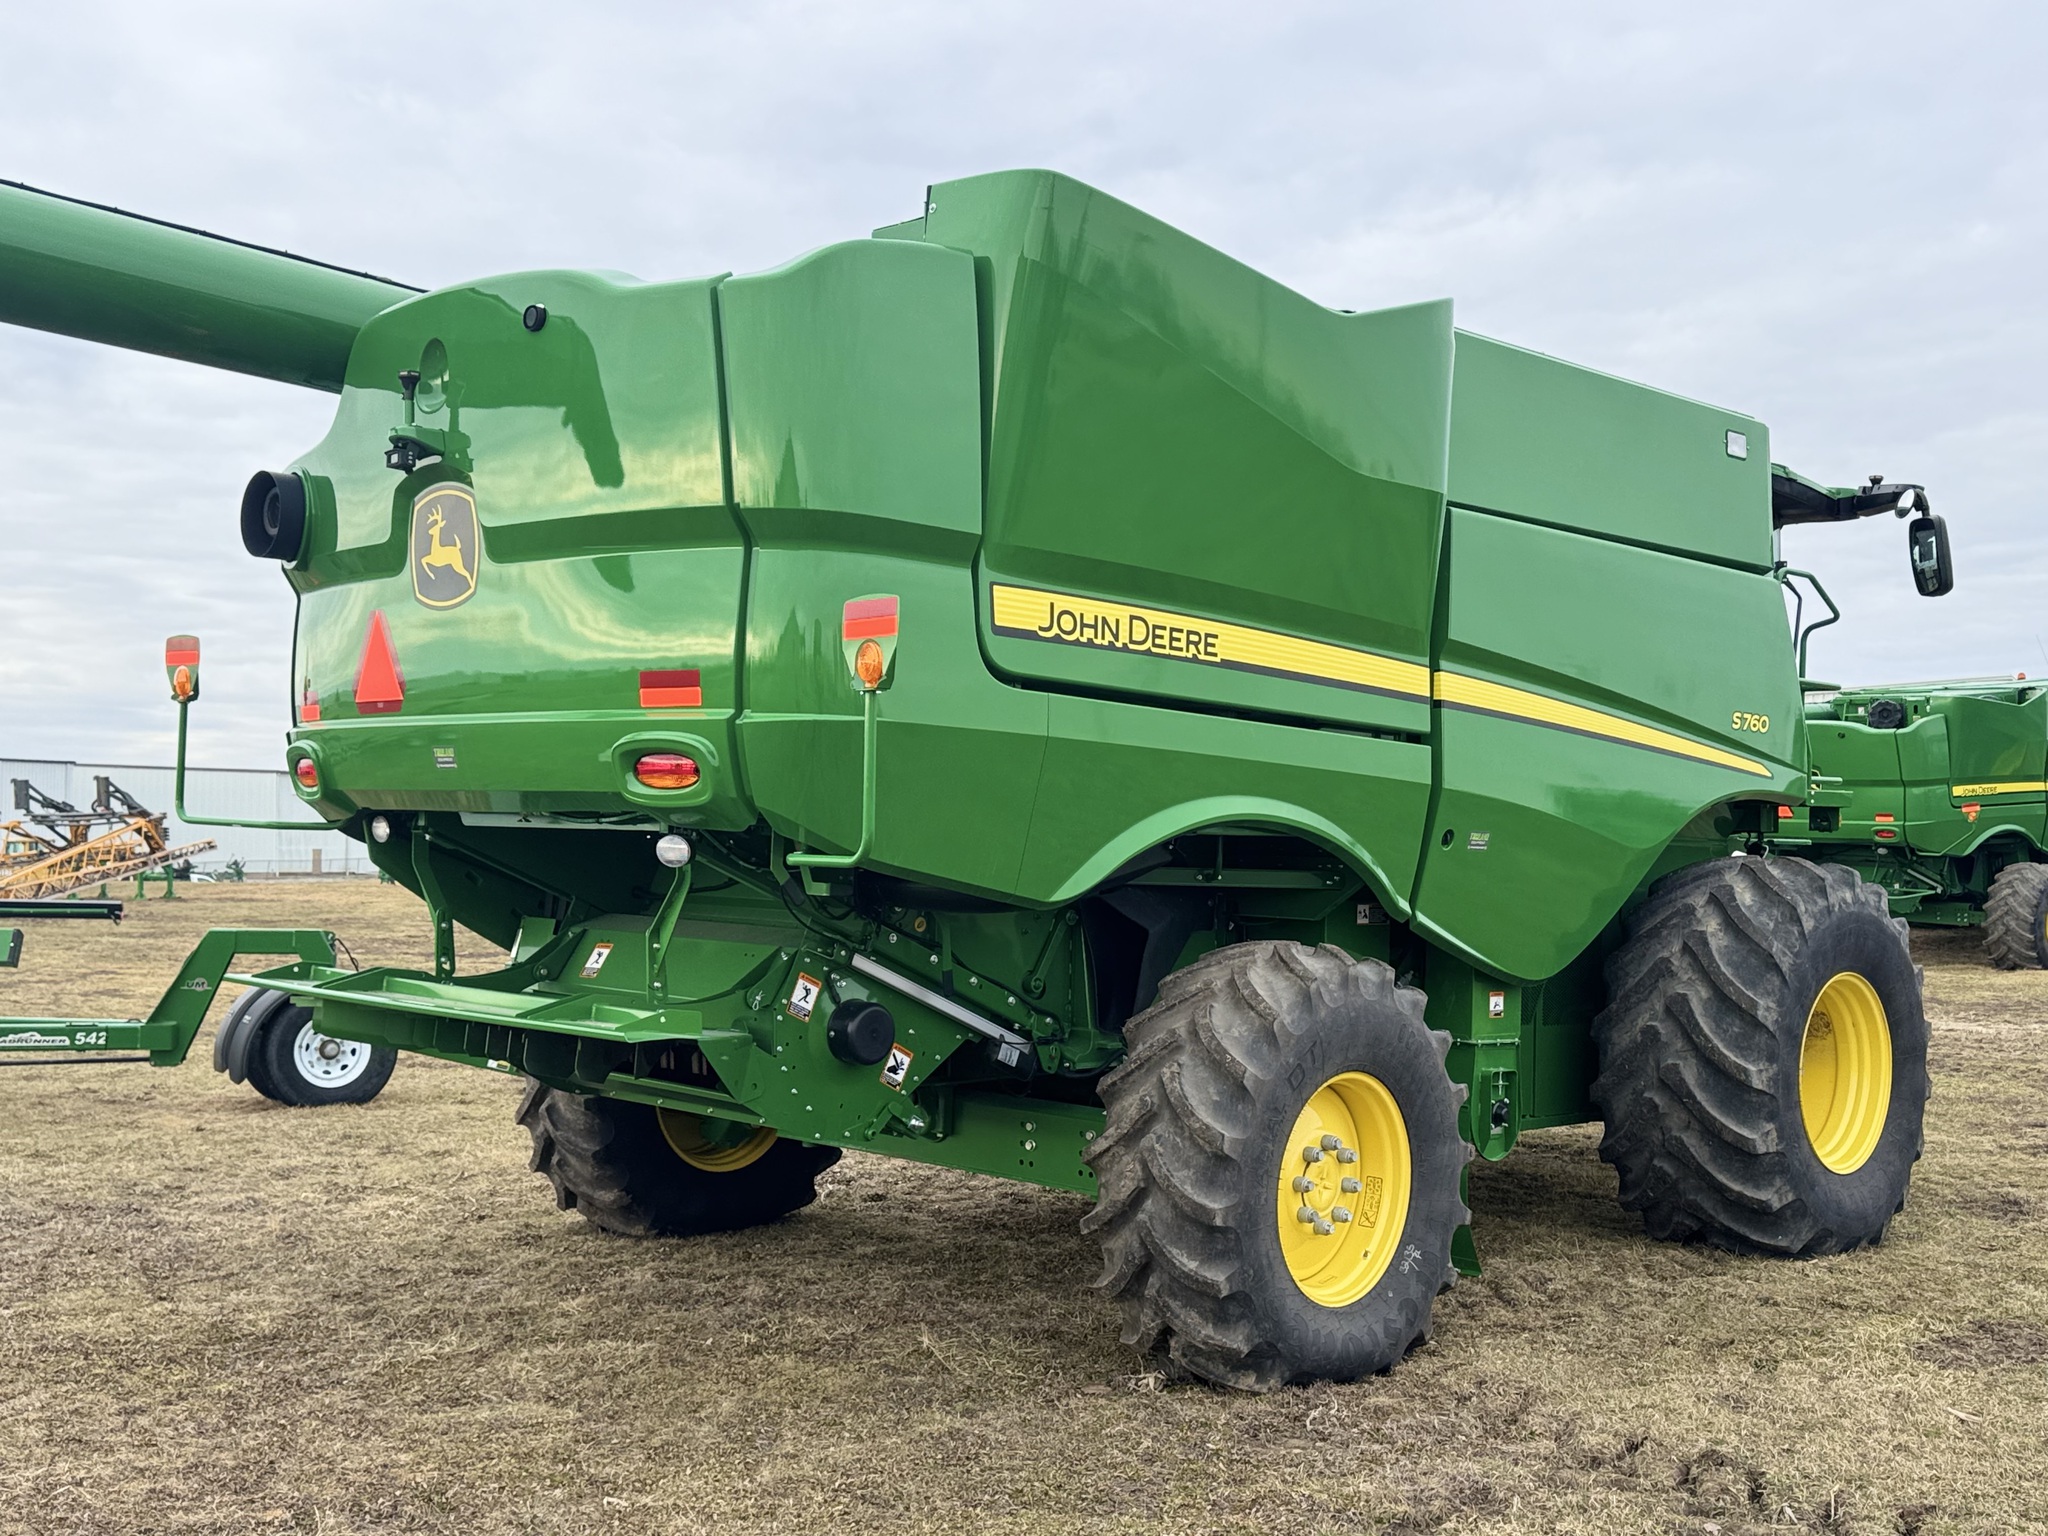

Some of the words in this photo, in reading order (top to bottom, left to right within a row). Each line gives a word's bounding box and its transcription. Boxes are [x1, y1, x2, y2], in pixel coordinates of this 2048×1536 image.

[1038, 601, 1120, 642] JOHN
[1128, 614, 1219, 658] DEERE
[1731, 711, 1769, 733] S760
[74, 1031, 107, 1045] 542
